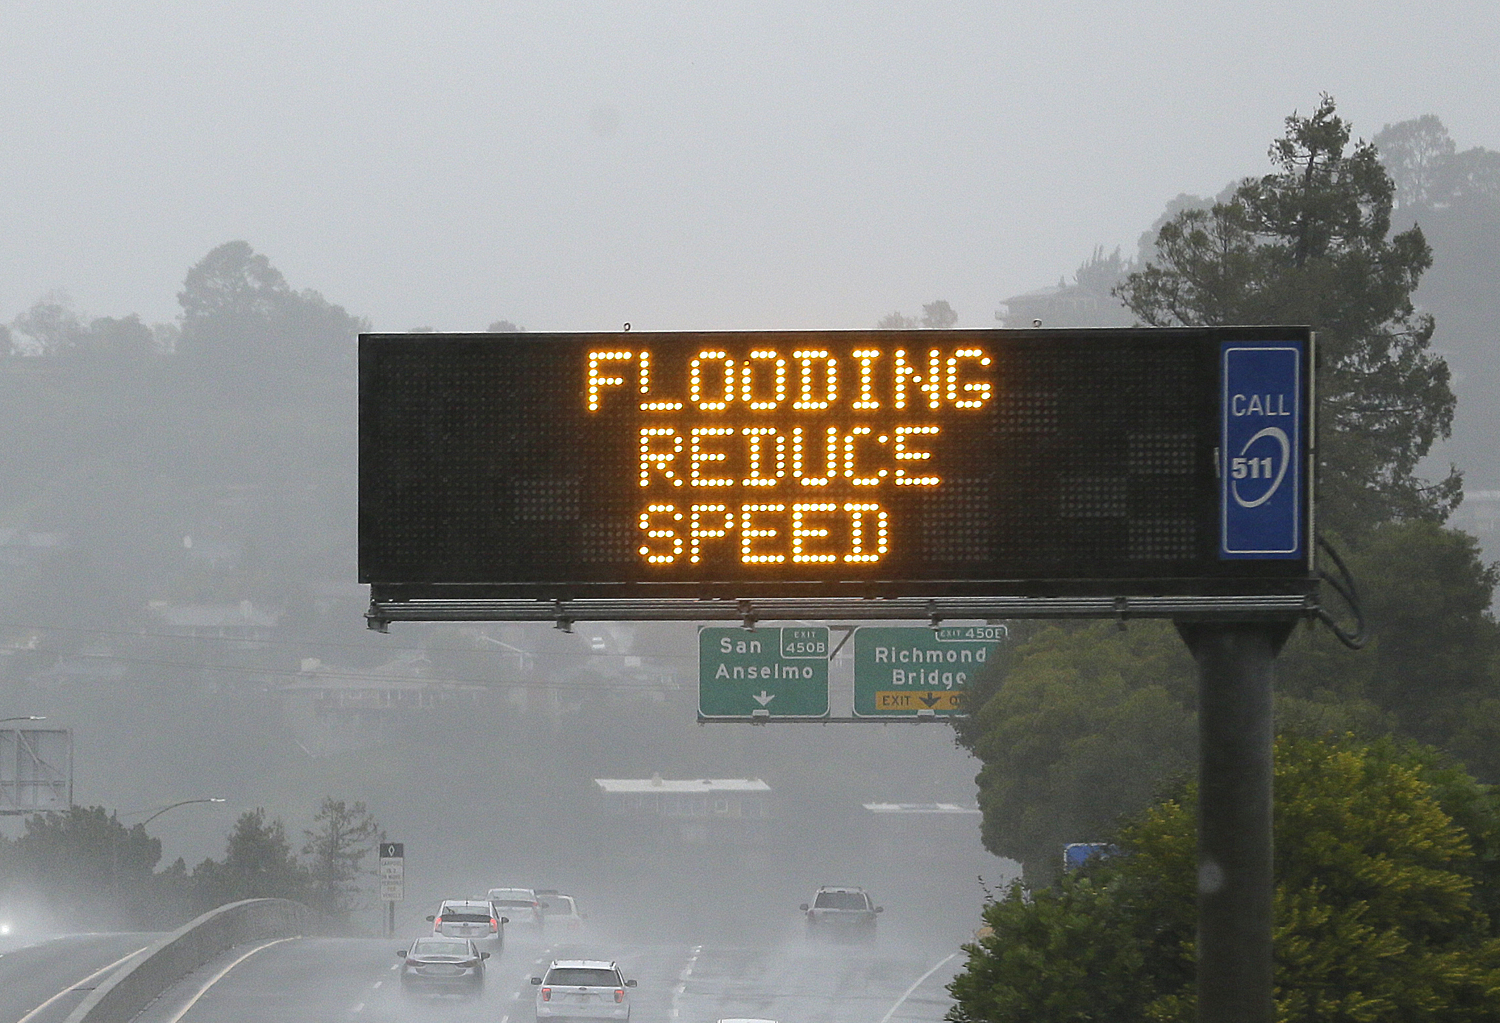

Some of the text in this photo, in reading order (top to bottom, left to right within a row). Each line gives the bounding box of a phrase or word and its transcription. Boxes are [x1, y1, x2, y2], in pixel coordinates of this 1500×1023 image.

[587, 349, 993, 412] FLOODING
[1231, 393, 1291, 417] CALL
[637, 426, 941, 488] REDUCE
[1231, 457, 1273, 479] 511
[637, 502, 889, 564] SPEED
[793, 631, 816, 639] EXIT
[940, 629, 961, 638] EXIT
[720, 637, 762, 654] San
[785, 642, 825, 653] 450B
[875, 647, 986, 663] Richmond
[715, 663, 814, 679] Anselmo
[892, 668, 967, 690] Bridge
[882, 695, 911, 706] EXIT
